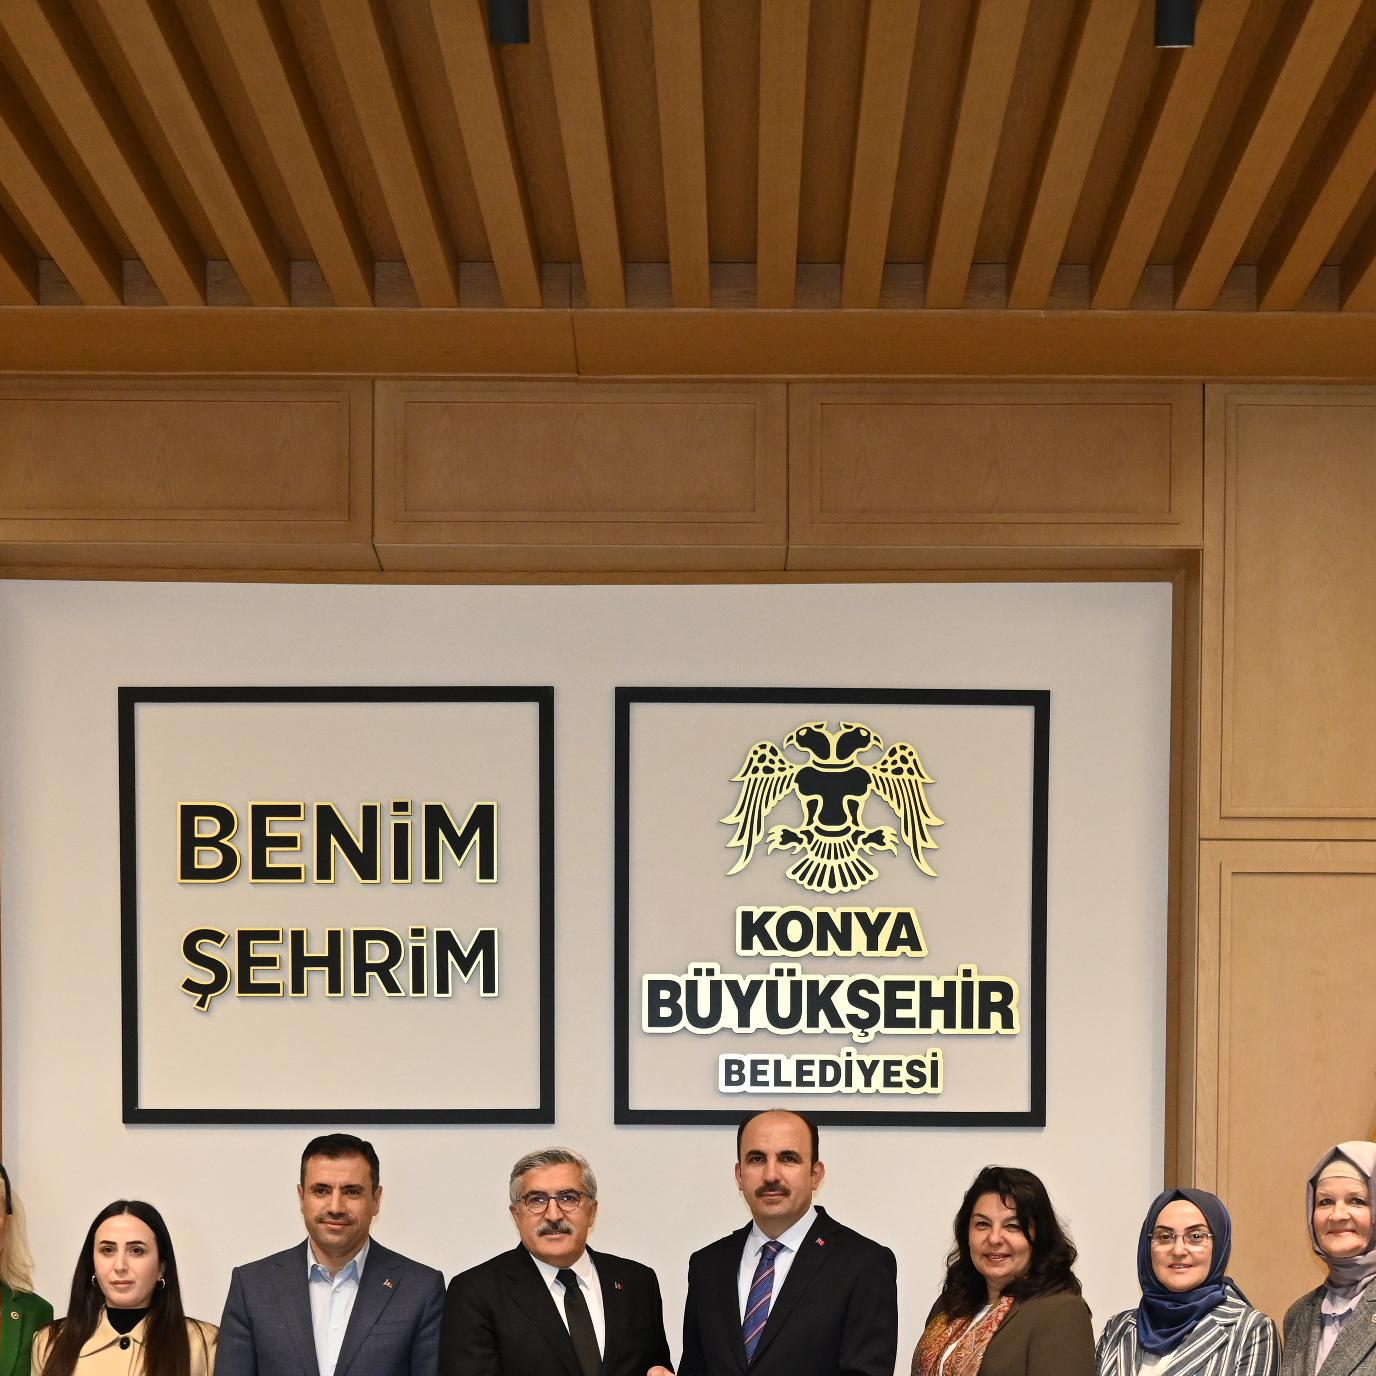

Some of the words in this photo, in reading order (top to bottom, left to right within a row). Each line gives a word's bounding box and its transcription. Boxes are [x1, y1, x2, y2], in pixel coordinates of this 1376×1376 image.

[739, 909, 925, 953] KONYA
[646, 967, 1016, 1038] BÜYÜKŞEHİR
[723, 1051, 940, 1090] BELEDİYESİ
